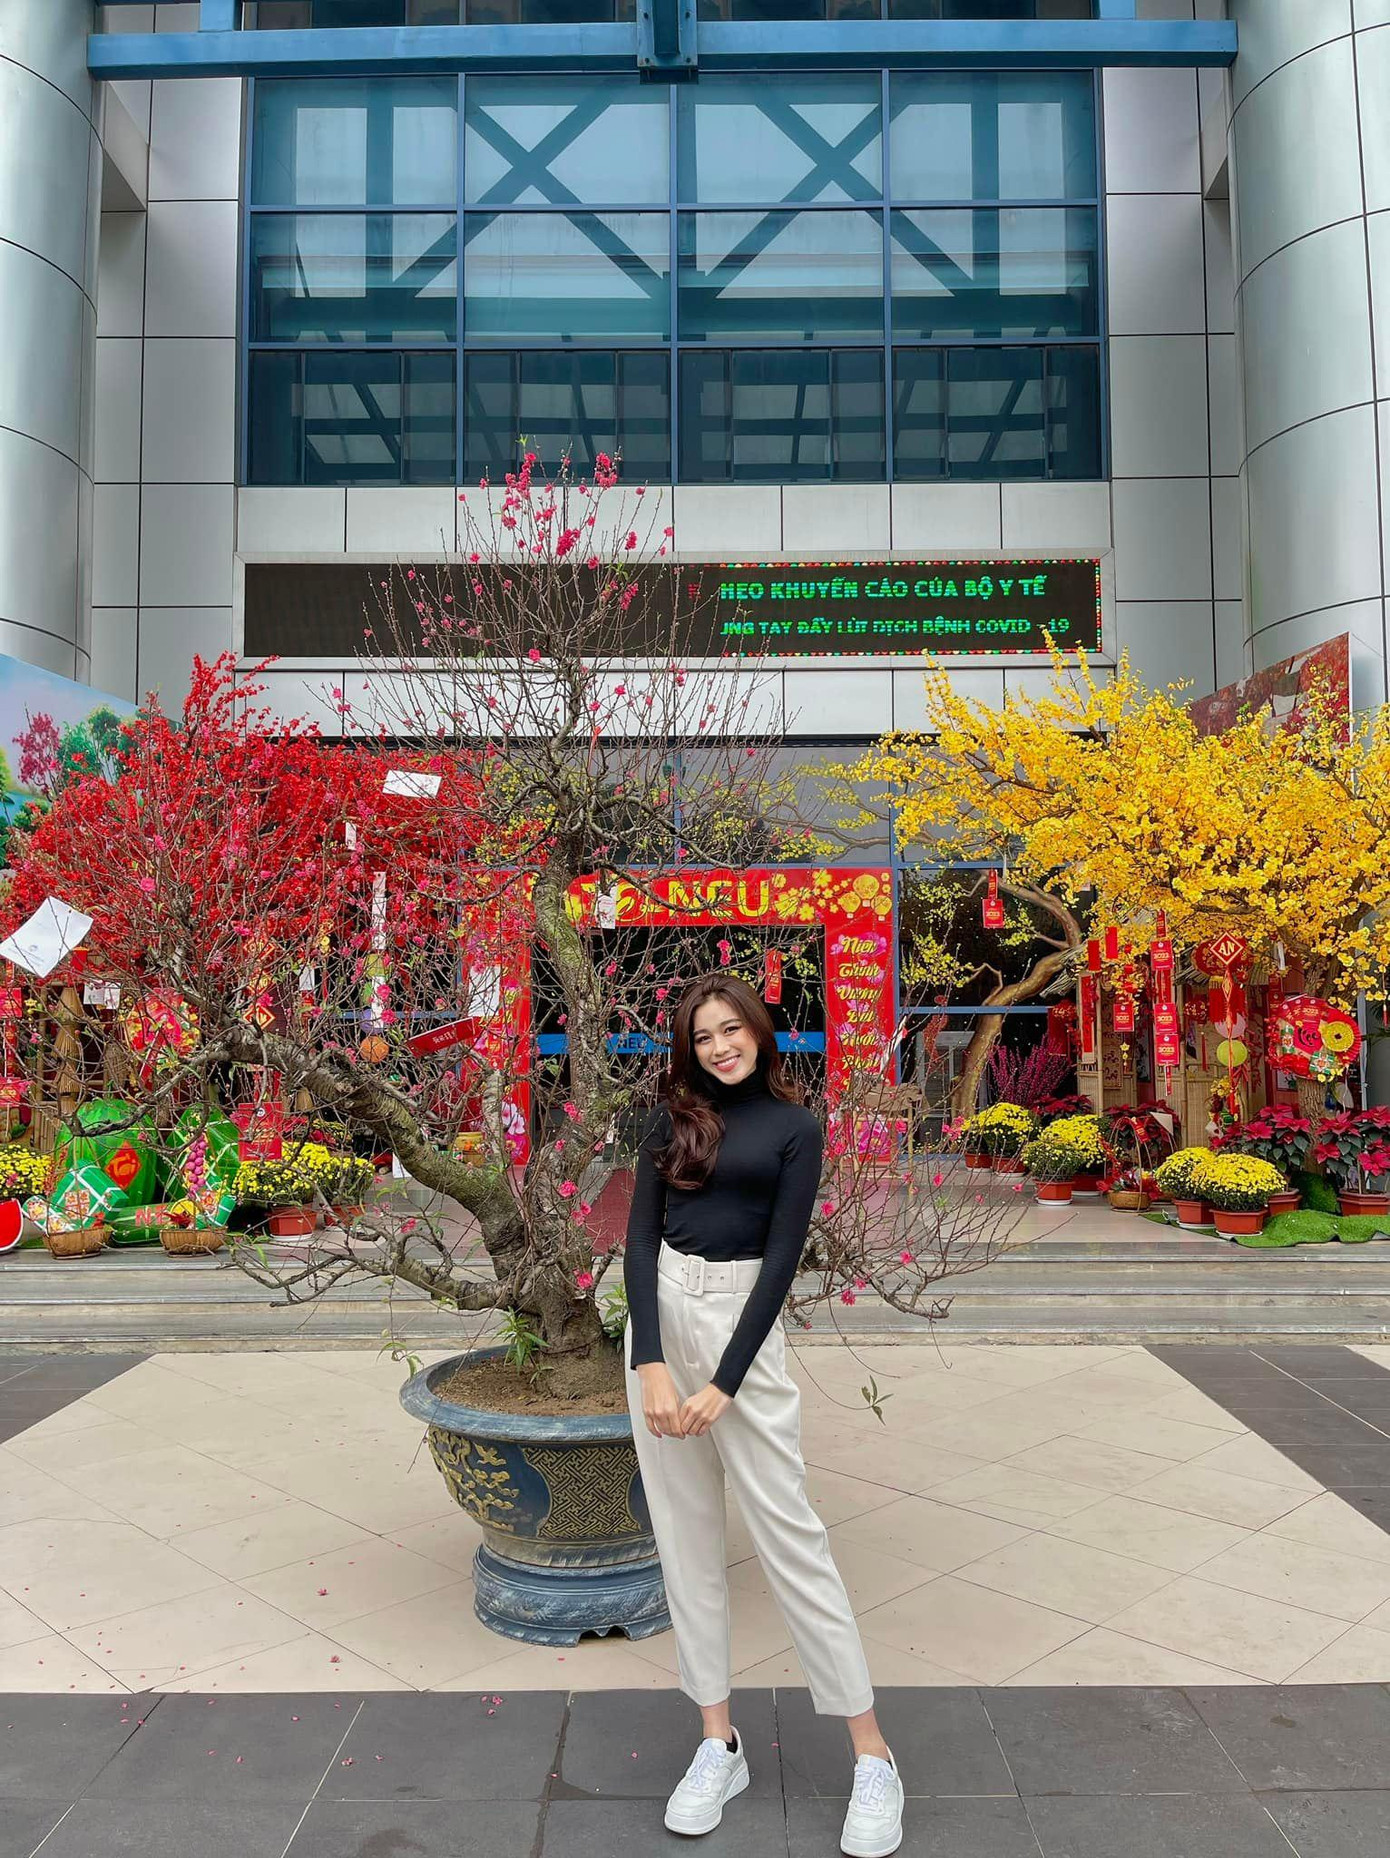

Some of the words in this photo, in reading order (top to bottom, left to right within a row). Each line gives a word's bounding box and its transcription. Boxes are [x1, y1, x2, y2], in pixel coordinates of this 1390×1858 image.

[865, 577, 909, 599] CÁO
[965, 575, 994, 600] BỘ
[998, 579, 1014, 597] Y
[1018, 574, 1047, 596] TẾ
[758, 621, 793, 636] TAY
[872, 618, 918, 636] DỊCH
[922, 615, 970, 636] BỆNH
[975, 619, 1031, 634] COVID
[1048, 618, 1070, 634] 19
[1218, 940, 1235, 956] AN
